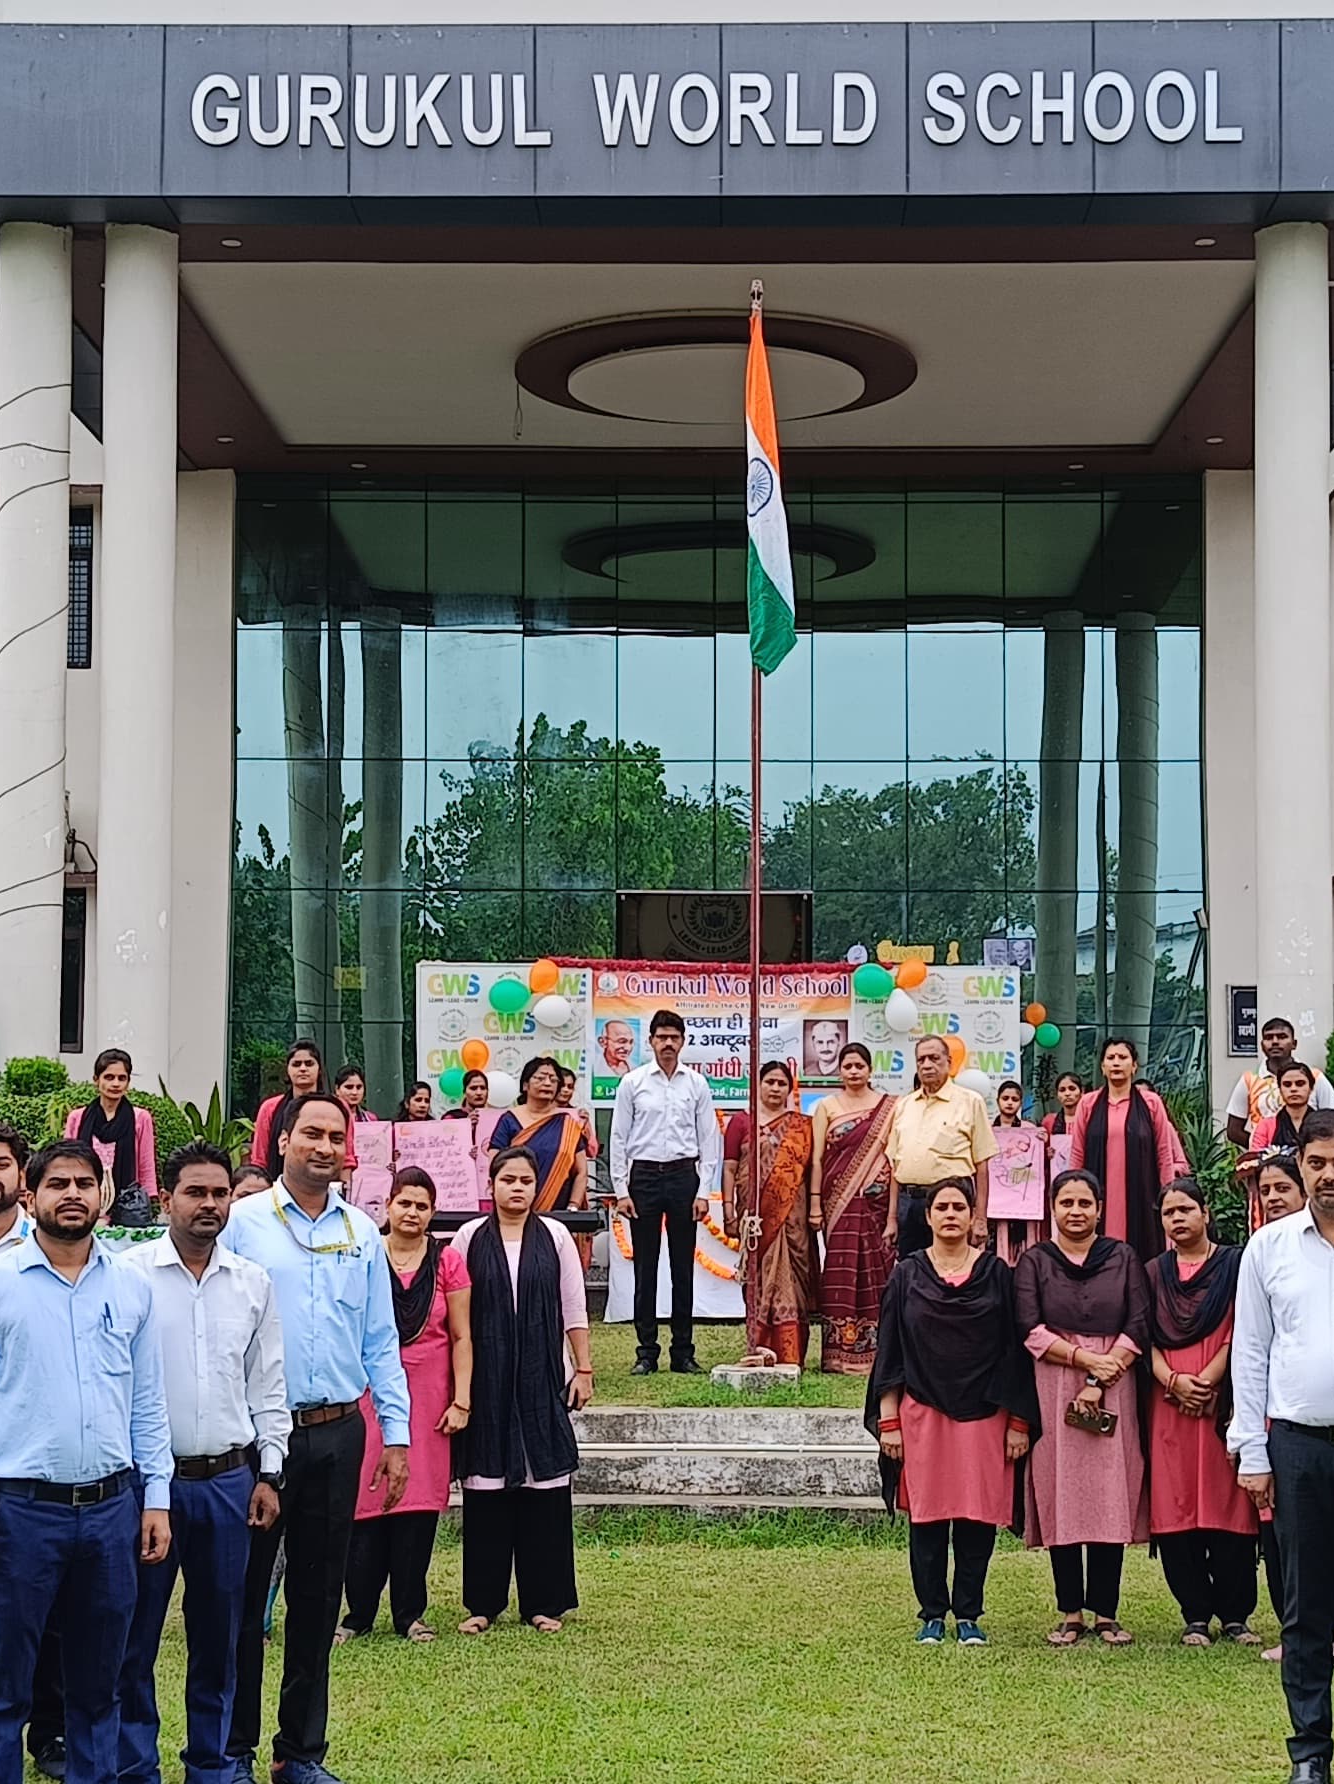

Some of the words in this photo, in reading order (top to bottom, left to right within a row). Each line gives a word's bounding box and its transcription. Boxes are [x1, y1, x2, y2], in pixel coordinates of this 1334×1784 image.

[190, 73, 553, 148] GURUKUL
[592, 72, 878, 147] WORLD
[922, 69, 1244, 145] SCHOOL
[427, 973, 480, 996] GWS
[555, 973, 586, 996] WS
[625, 974, 708, 996] Gurukul
[780, 975, 850, 996] School
[963, 975, 1015, 998] GWS
[483, 1011, 536, 1033] GWS
[427, 1049, 465, 1071] GW
